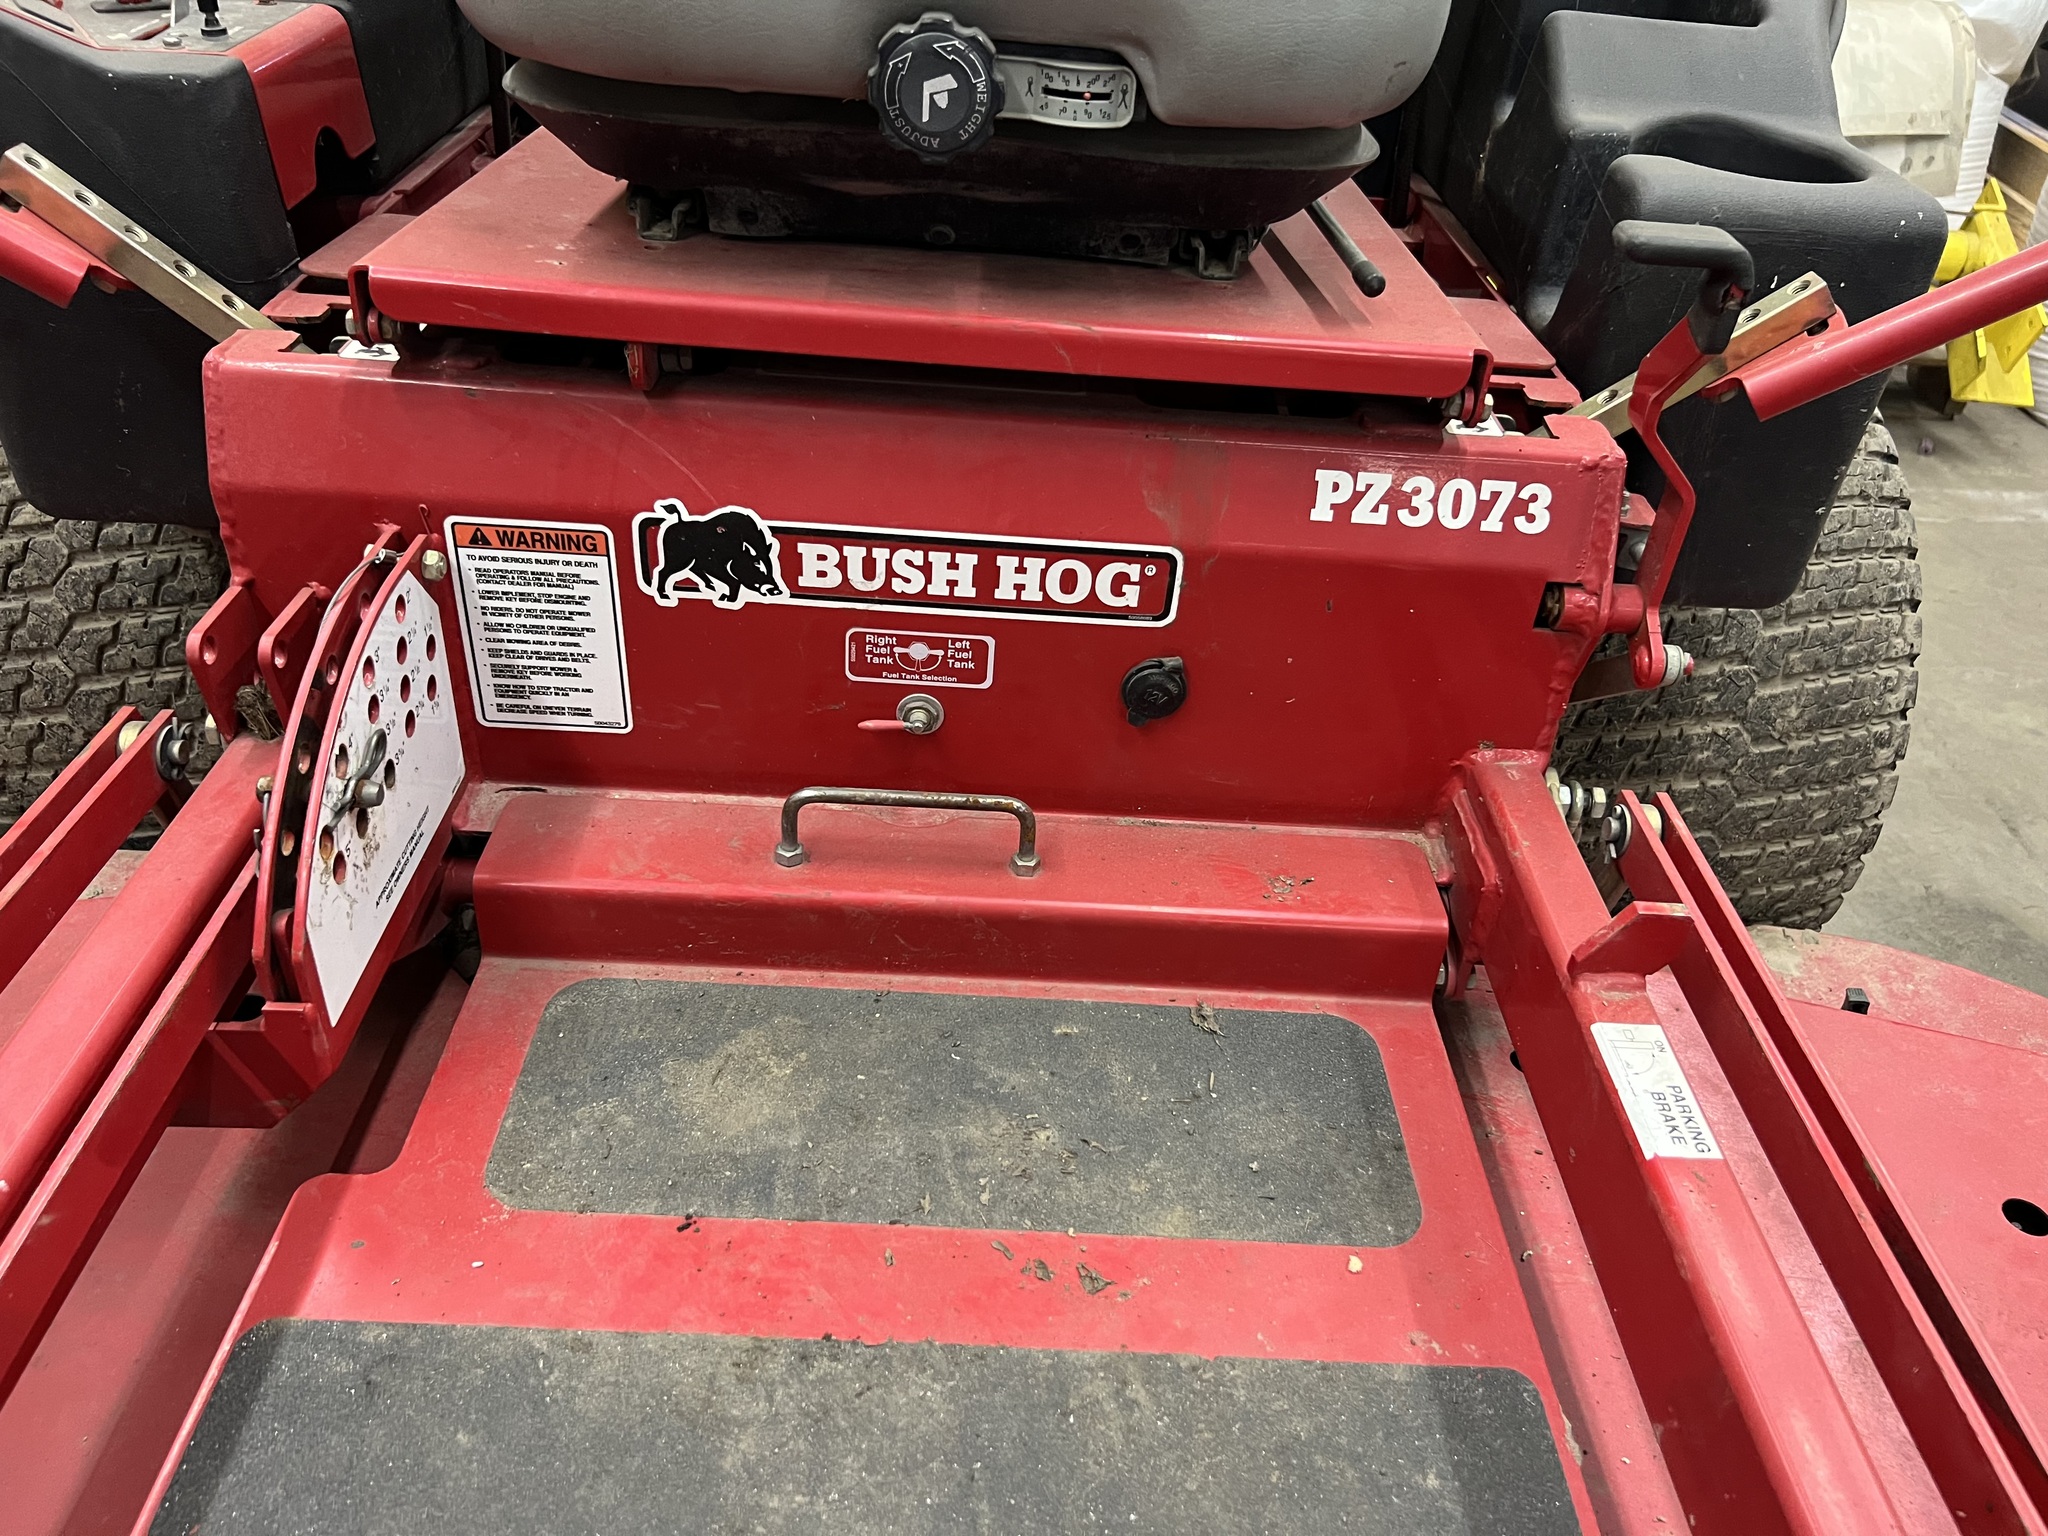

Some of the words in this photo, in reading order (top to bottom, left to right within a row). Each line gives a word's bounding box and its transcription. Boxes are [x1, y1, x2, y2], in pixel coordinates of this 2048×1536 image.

[1041, 69, 1053, 82] 100
[1086, 74, 1100, 88] 200
[958, 81, 987, 140] WEIGHT
[889, 108, 940, 148] ADJUST
[496, 530, 598, 553] WARNING
[797, 542, 978, 598] BUSH
[865, 634, 897, 645] Right
[948, 640, 970, 649] Left
[865, 645, 890, 654] Fuel
[865, 654, 893, 664] Tank
[948, 650, 972, 659] Fuel
[947, 660, 975, 669] Tank
[1144, 689, 1168, 704] 12V
[394, 856, 410, 887] OWNERS
[410, 830, 424, 858] MANUAL
[376, 857, 401, 909] APPROXIMATE
[402, 829, 417, 859] CUTTING
[1654, 1040, 1667, 1053] ON
[1651, 1091, 1688, 1146] BRAKE
[1667, 1085, 1711, 1154] PARKING
